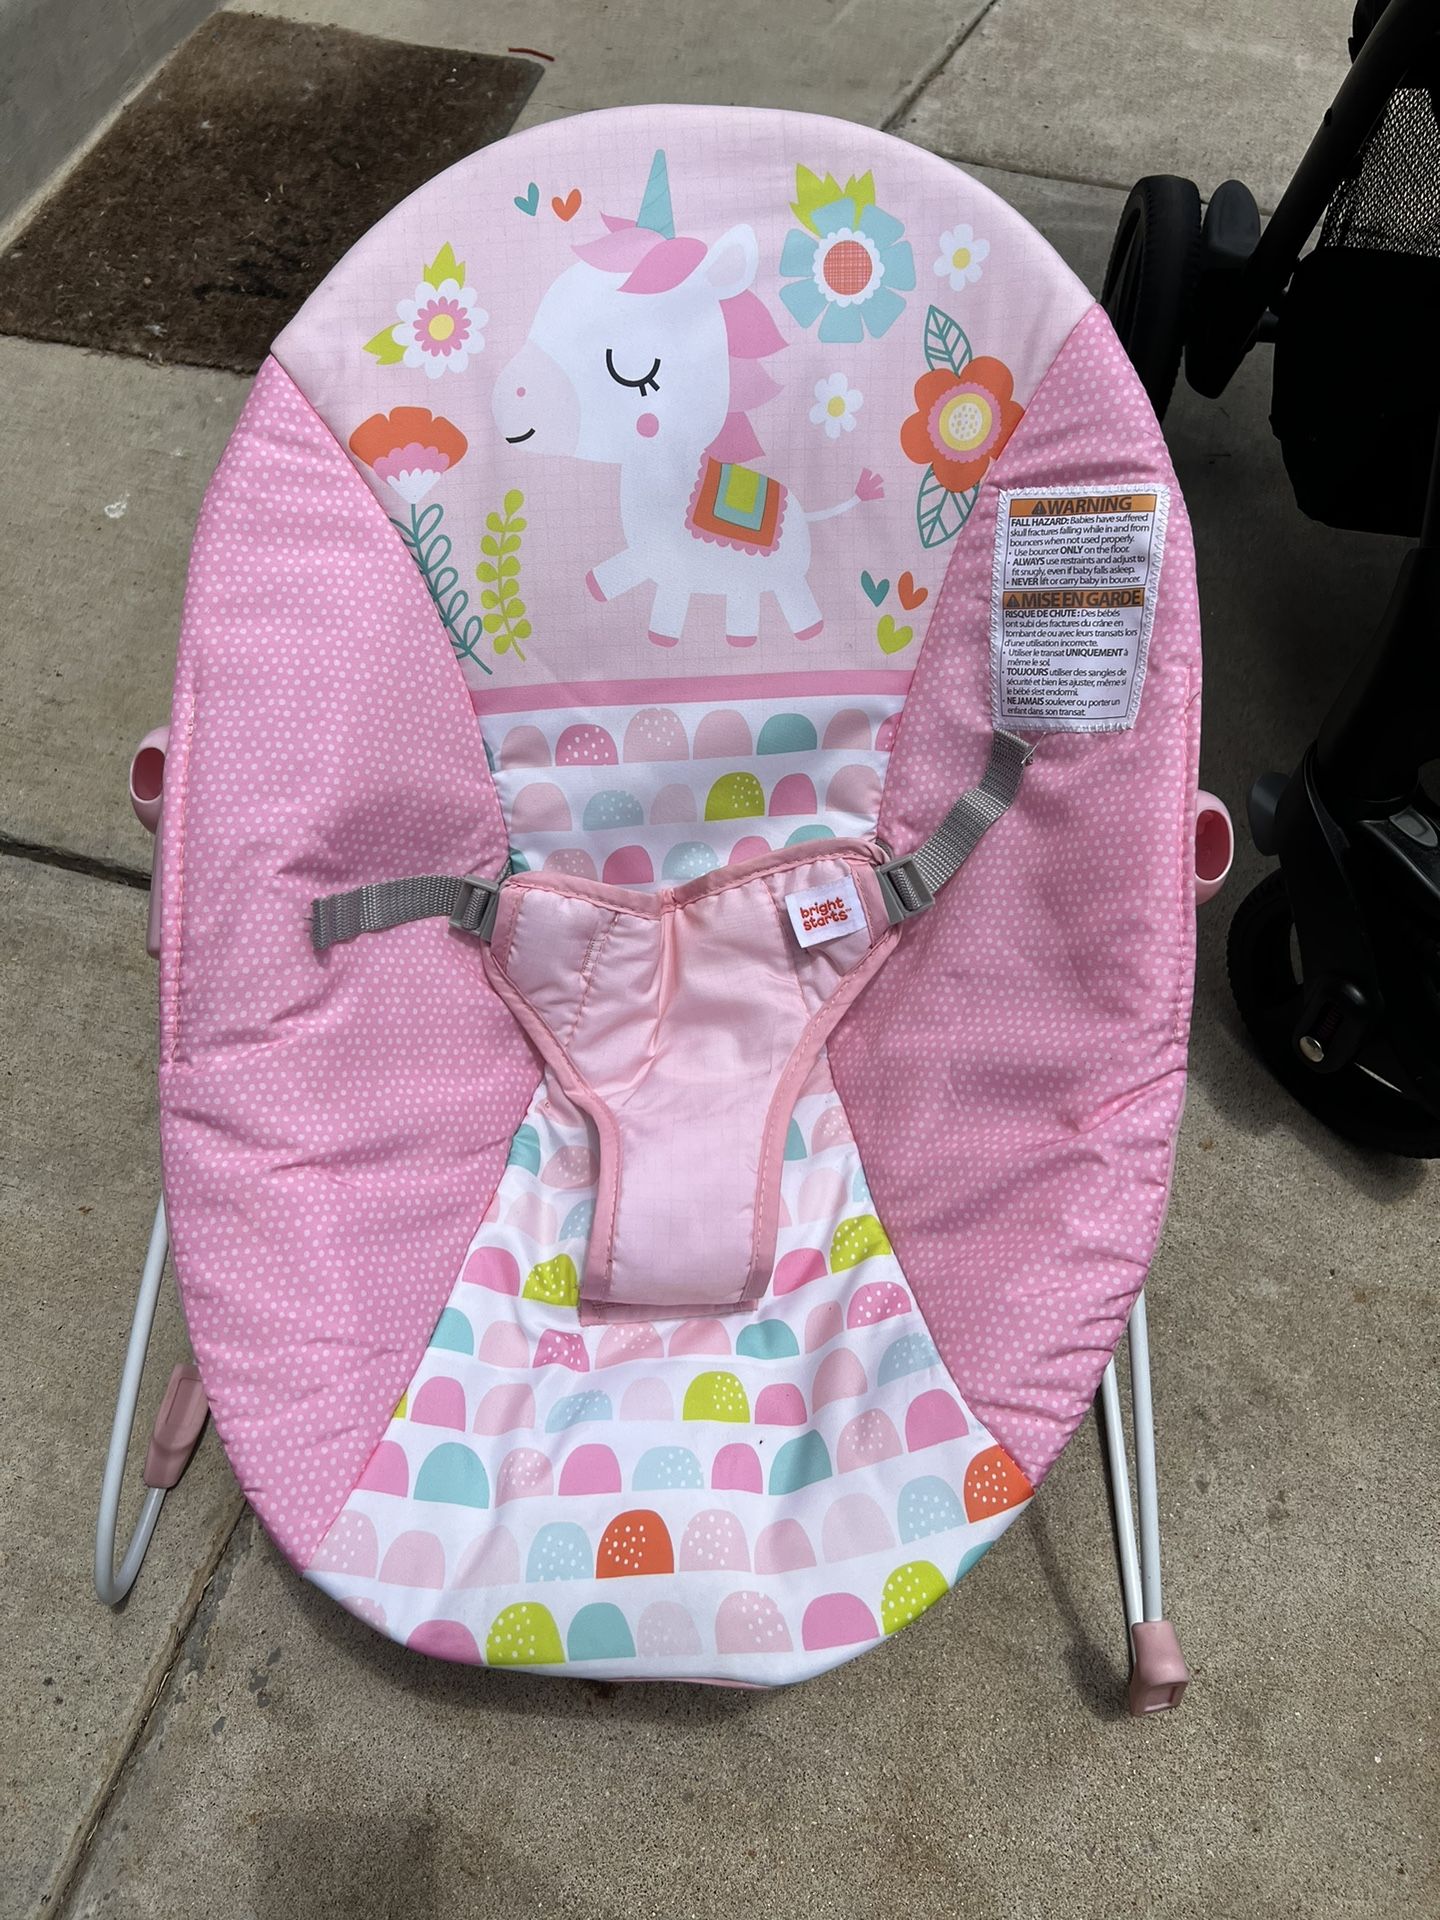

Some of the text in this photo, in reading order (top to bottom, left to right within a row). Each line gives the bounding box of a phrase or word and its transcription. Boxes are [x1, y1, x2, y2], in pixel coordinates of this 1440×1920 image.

[1047, 497, 1131, 515] WARNING
[1011, 513, 1148, 527] FALL HAZARD: Babies have suffered
[1028, 528, 1058, 536] fractures
[1060, 526, 1082, 535] falling
[1083, 525, 1104, 534] while
[1114, 524, 1129, 532] and
[1130, 523, 1150, 532] from
[1044, 537, 1066, 545] when
[1081, 536, 1100, 544] used
[1102, 534, 1134, 545] properly.
[1060, 546, 1083, 554] ONLY
[1096, 545, 1110, 554] the
[1012, 557, 1045, 566] ALWAYS
[1060, 556, 1094, 564] restraints
[1096, 556, 1112, 564] and
[1112, 555, 1136, 564] adjust
[1012, 568, 1020, 576] fit
[1020, 567, 1046, 578] snugly,
[1067, 566, 1072, 574] if
[1073, 566, 1092, 576] baby
[1094, 566, 1108, 574] falls
[1012, 578, 1038, 586] NEVER
[1040, 576, 1049, 585] lift
[1060, 578, 1078, 587] carry
[1080, 576, 1100, 587] baby
[1100, 576, 1108, 584] in
[1022, 590, 1141, 608] MISE EN GARDE
[1081, 610, 1096, 618] Des
[1097, 610, 1120, 618] bébés
[1020, 620, 1034, 628] subi
[1036, 620, 1048, 628] des
[1050, 619, 1080, 628] fractures
[1080, 619, 1091, 627] du
[1092, 619, 1112, 627] crâne
[1076, 629, 1094, 637] leurs
[1125, 628, 1138, 636] lors
[1004, 638, 1098, 647] d'une utilisation incorrecte.
[1033, 648, 1040, 656] le
[1066, 648, 1123, 657] UNIQUEMENT
[1008, 658, 1031, 666] même
[1032, 658, 1038, 666] le
[1006, 668, 1127, 679] TOUJOURS utiliser des sangles de
[1006, 678, 1032, 686] sécurité
[1042, 678, 1058, 686] bien
[1058, 678, 1068, 686] les
[1069, 678, 1095, 688] ajuster,
[1096, 678, 1120, 686] même
[1121, 678, 1127, 686] si
[1006, 687, 1012, 696] le
[1013, 687, 1030, 696] bébé
[1018, 697, 1044, 705] JAMAIS
[1045, 698, 1076, 706] soulever
[1088, 700, 1111, 708] porter
[1008, 706, 1027, 714] enfant
[1028, 707, 1044, 715] dans
[800, 897, 845, 919] bright
